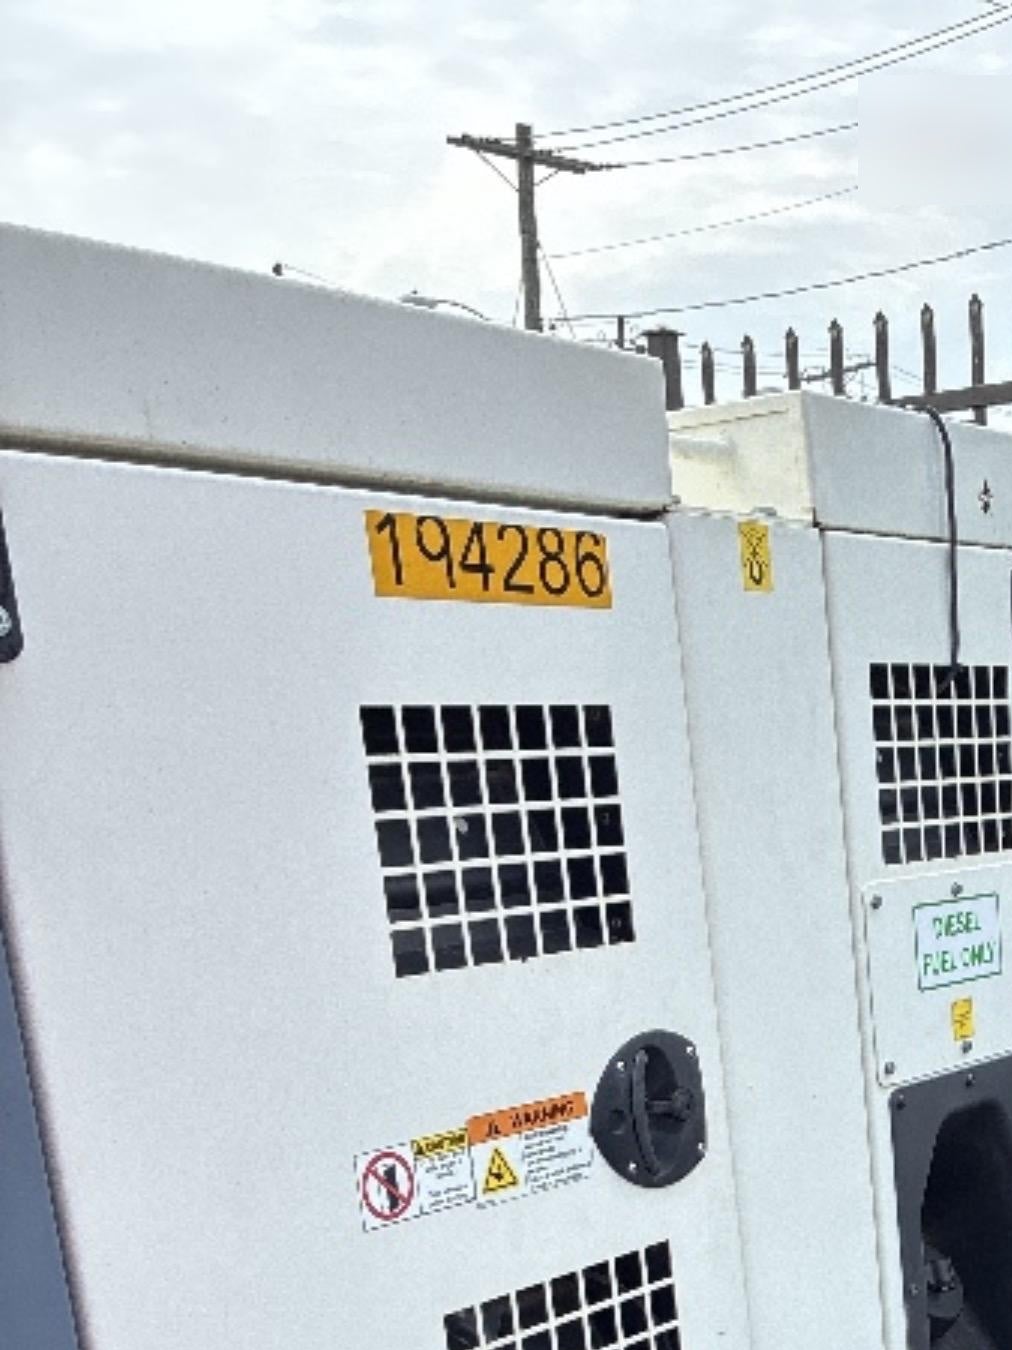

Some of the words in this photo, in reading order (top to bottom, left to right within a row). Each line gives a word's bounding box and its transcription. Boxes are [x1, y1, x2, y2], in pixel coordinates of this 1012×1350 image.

[376, 511, 608, 598] 194286
[932, 911, 981, 939] DIESEL
[923, 950, 958, 976] FUEL
[961, 940, 997, 967] ONLY
